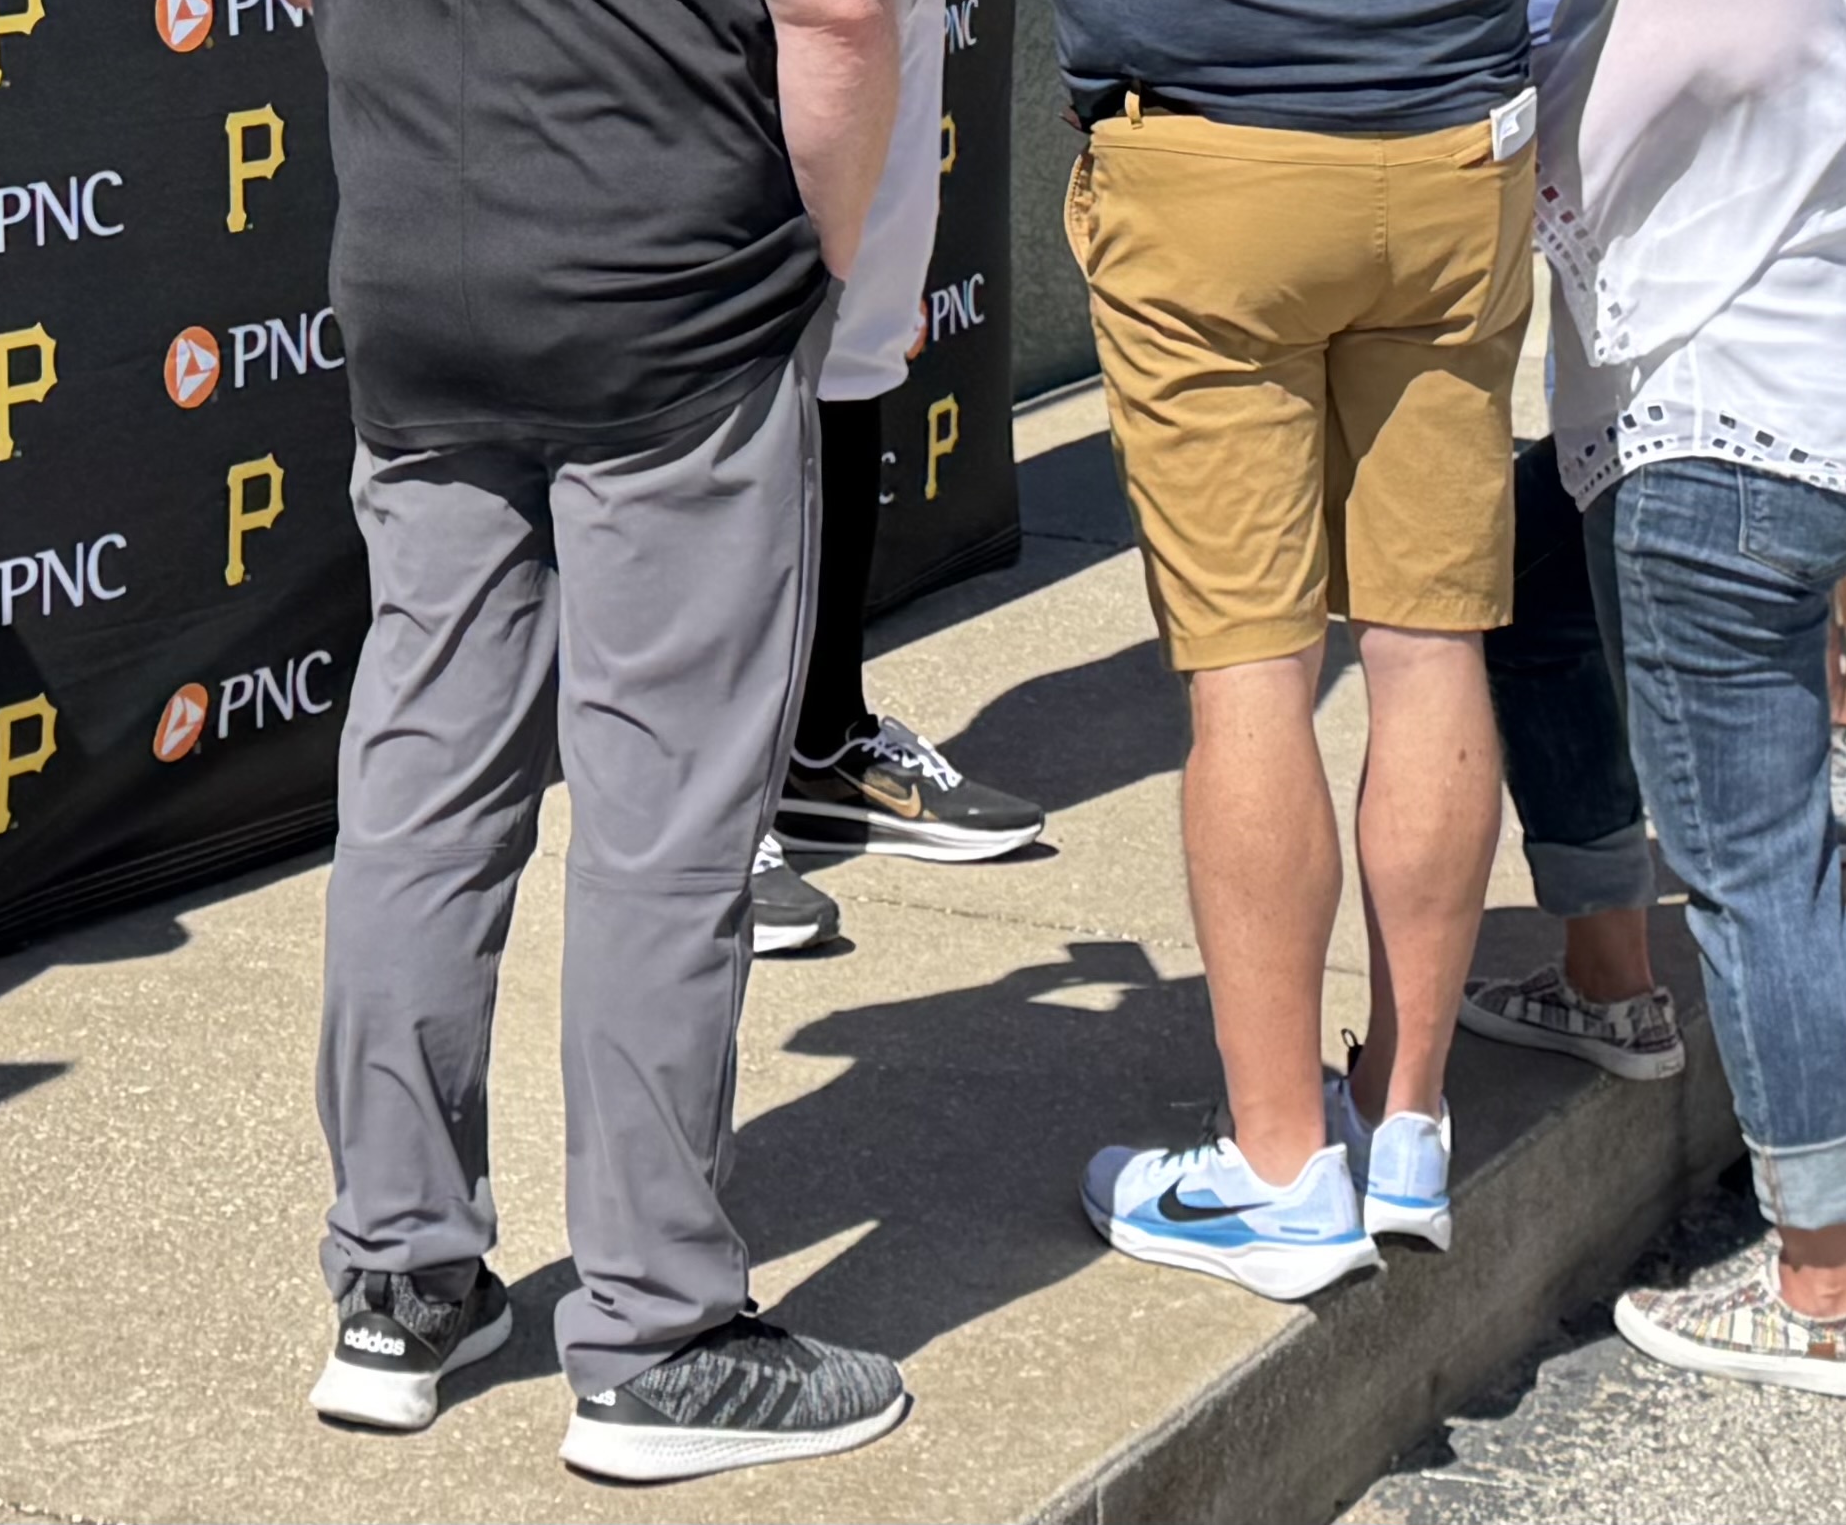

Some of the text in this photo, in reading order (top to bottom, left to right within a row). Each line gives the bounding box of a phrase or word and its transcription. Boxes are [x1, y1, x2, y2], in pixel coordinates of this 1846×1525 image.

[225, 104, 286, 234] P
[228, 306, 345, 389] PNC
[931, 273, 985, 341] PNC
[925, 393, 959, 500] P
[225, 453, 285, 586] P
[218, 649, 333, 739] PNC
[344, 1327, 405, 1356] adidas
